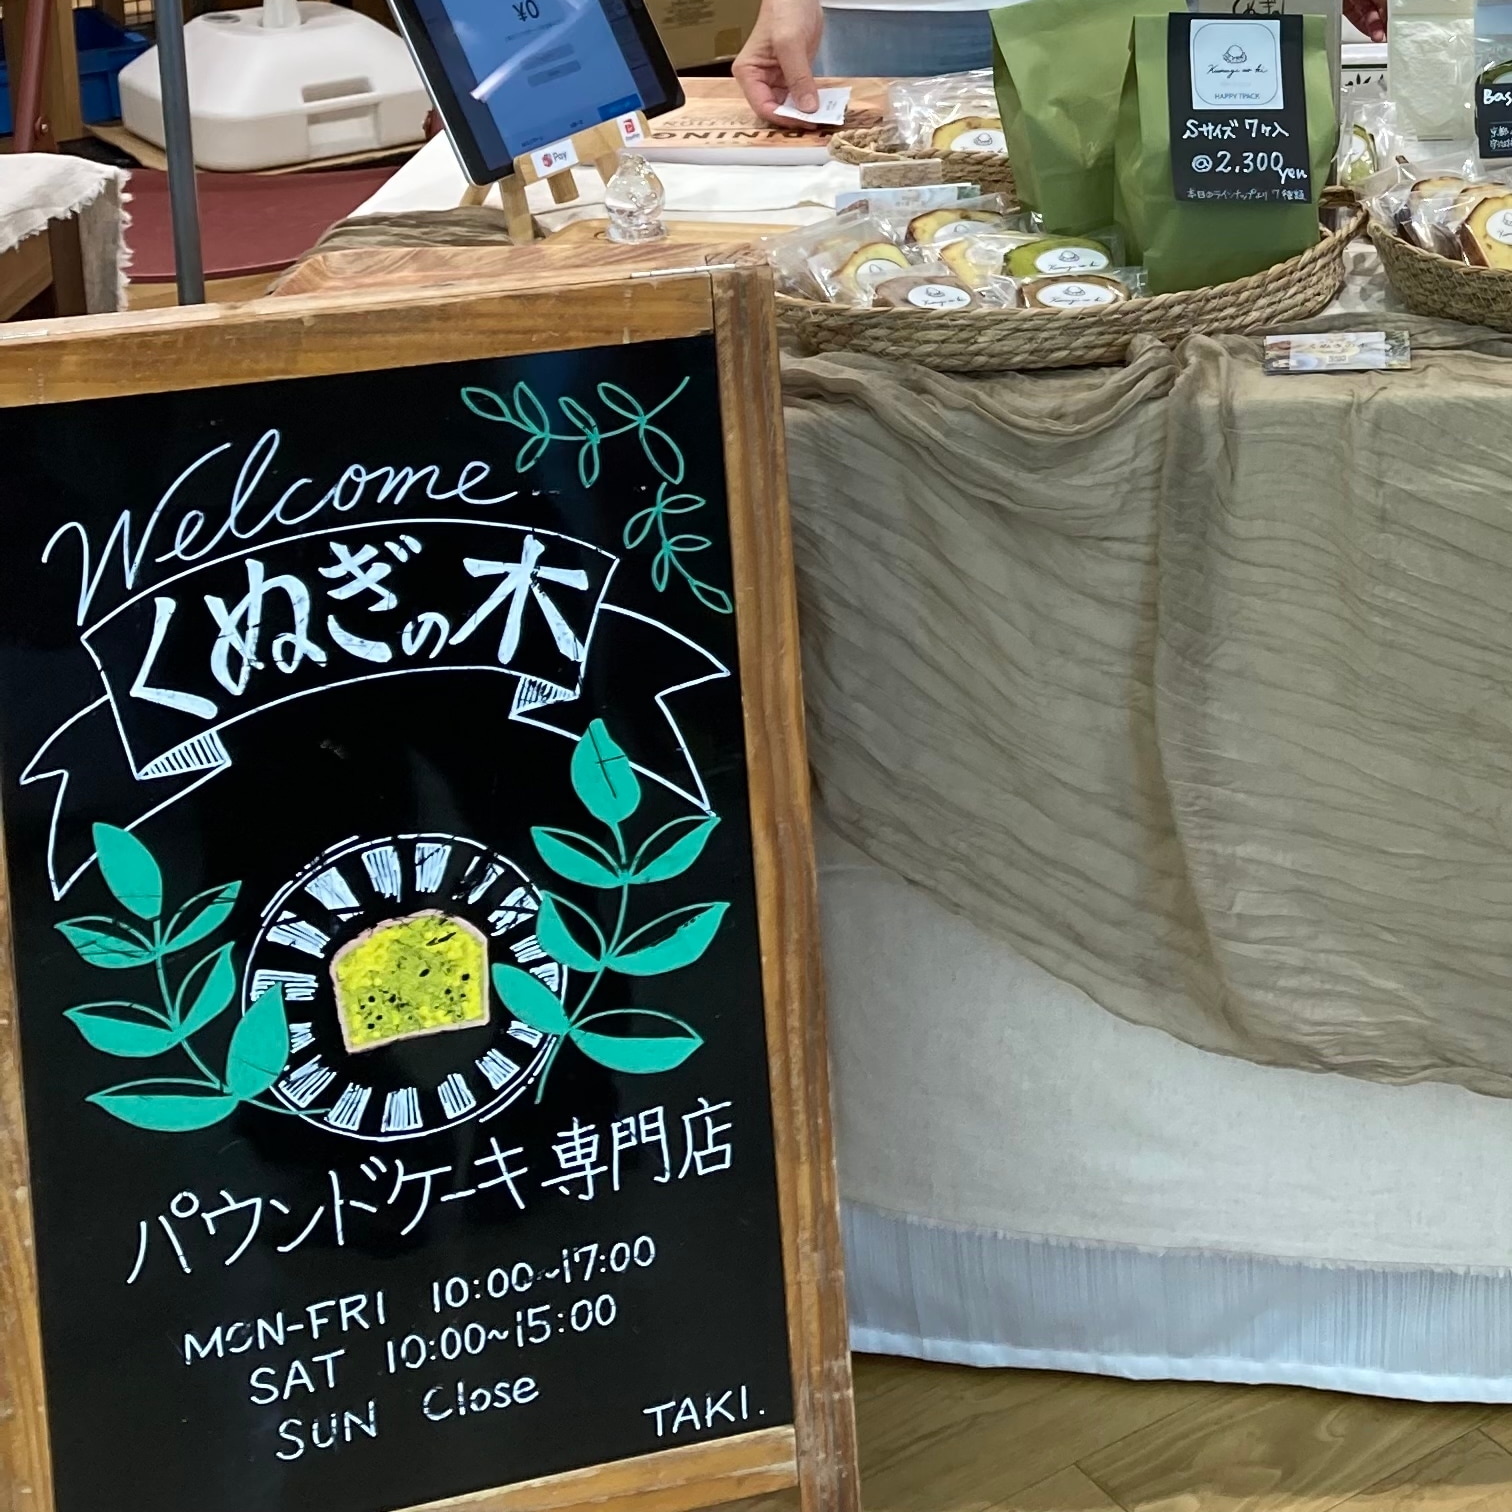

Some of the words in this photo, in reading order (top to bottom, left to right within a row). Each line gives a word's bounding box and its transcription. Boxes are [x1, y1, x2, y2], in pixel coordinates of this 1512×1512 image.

[1183, 119, 1239, 140] Sサイズ
[1214, 92, 1238, 100] HAPPY
[42, 428, 518, 626] Welcome
[130, 534, 590, 721] くぬぎの木
[126, 1097, 734, 1285] パウンドケーキ専門店
[183, 1289, 388, 1367] MON-FRI
[249, 1349, 346, 1406] SAT
[275, 1399, 378, 1461] SUN
[422, 1373, 540, 1423] Close
